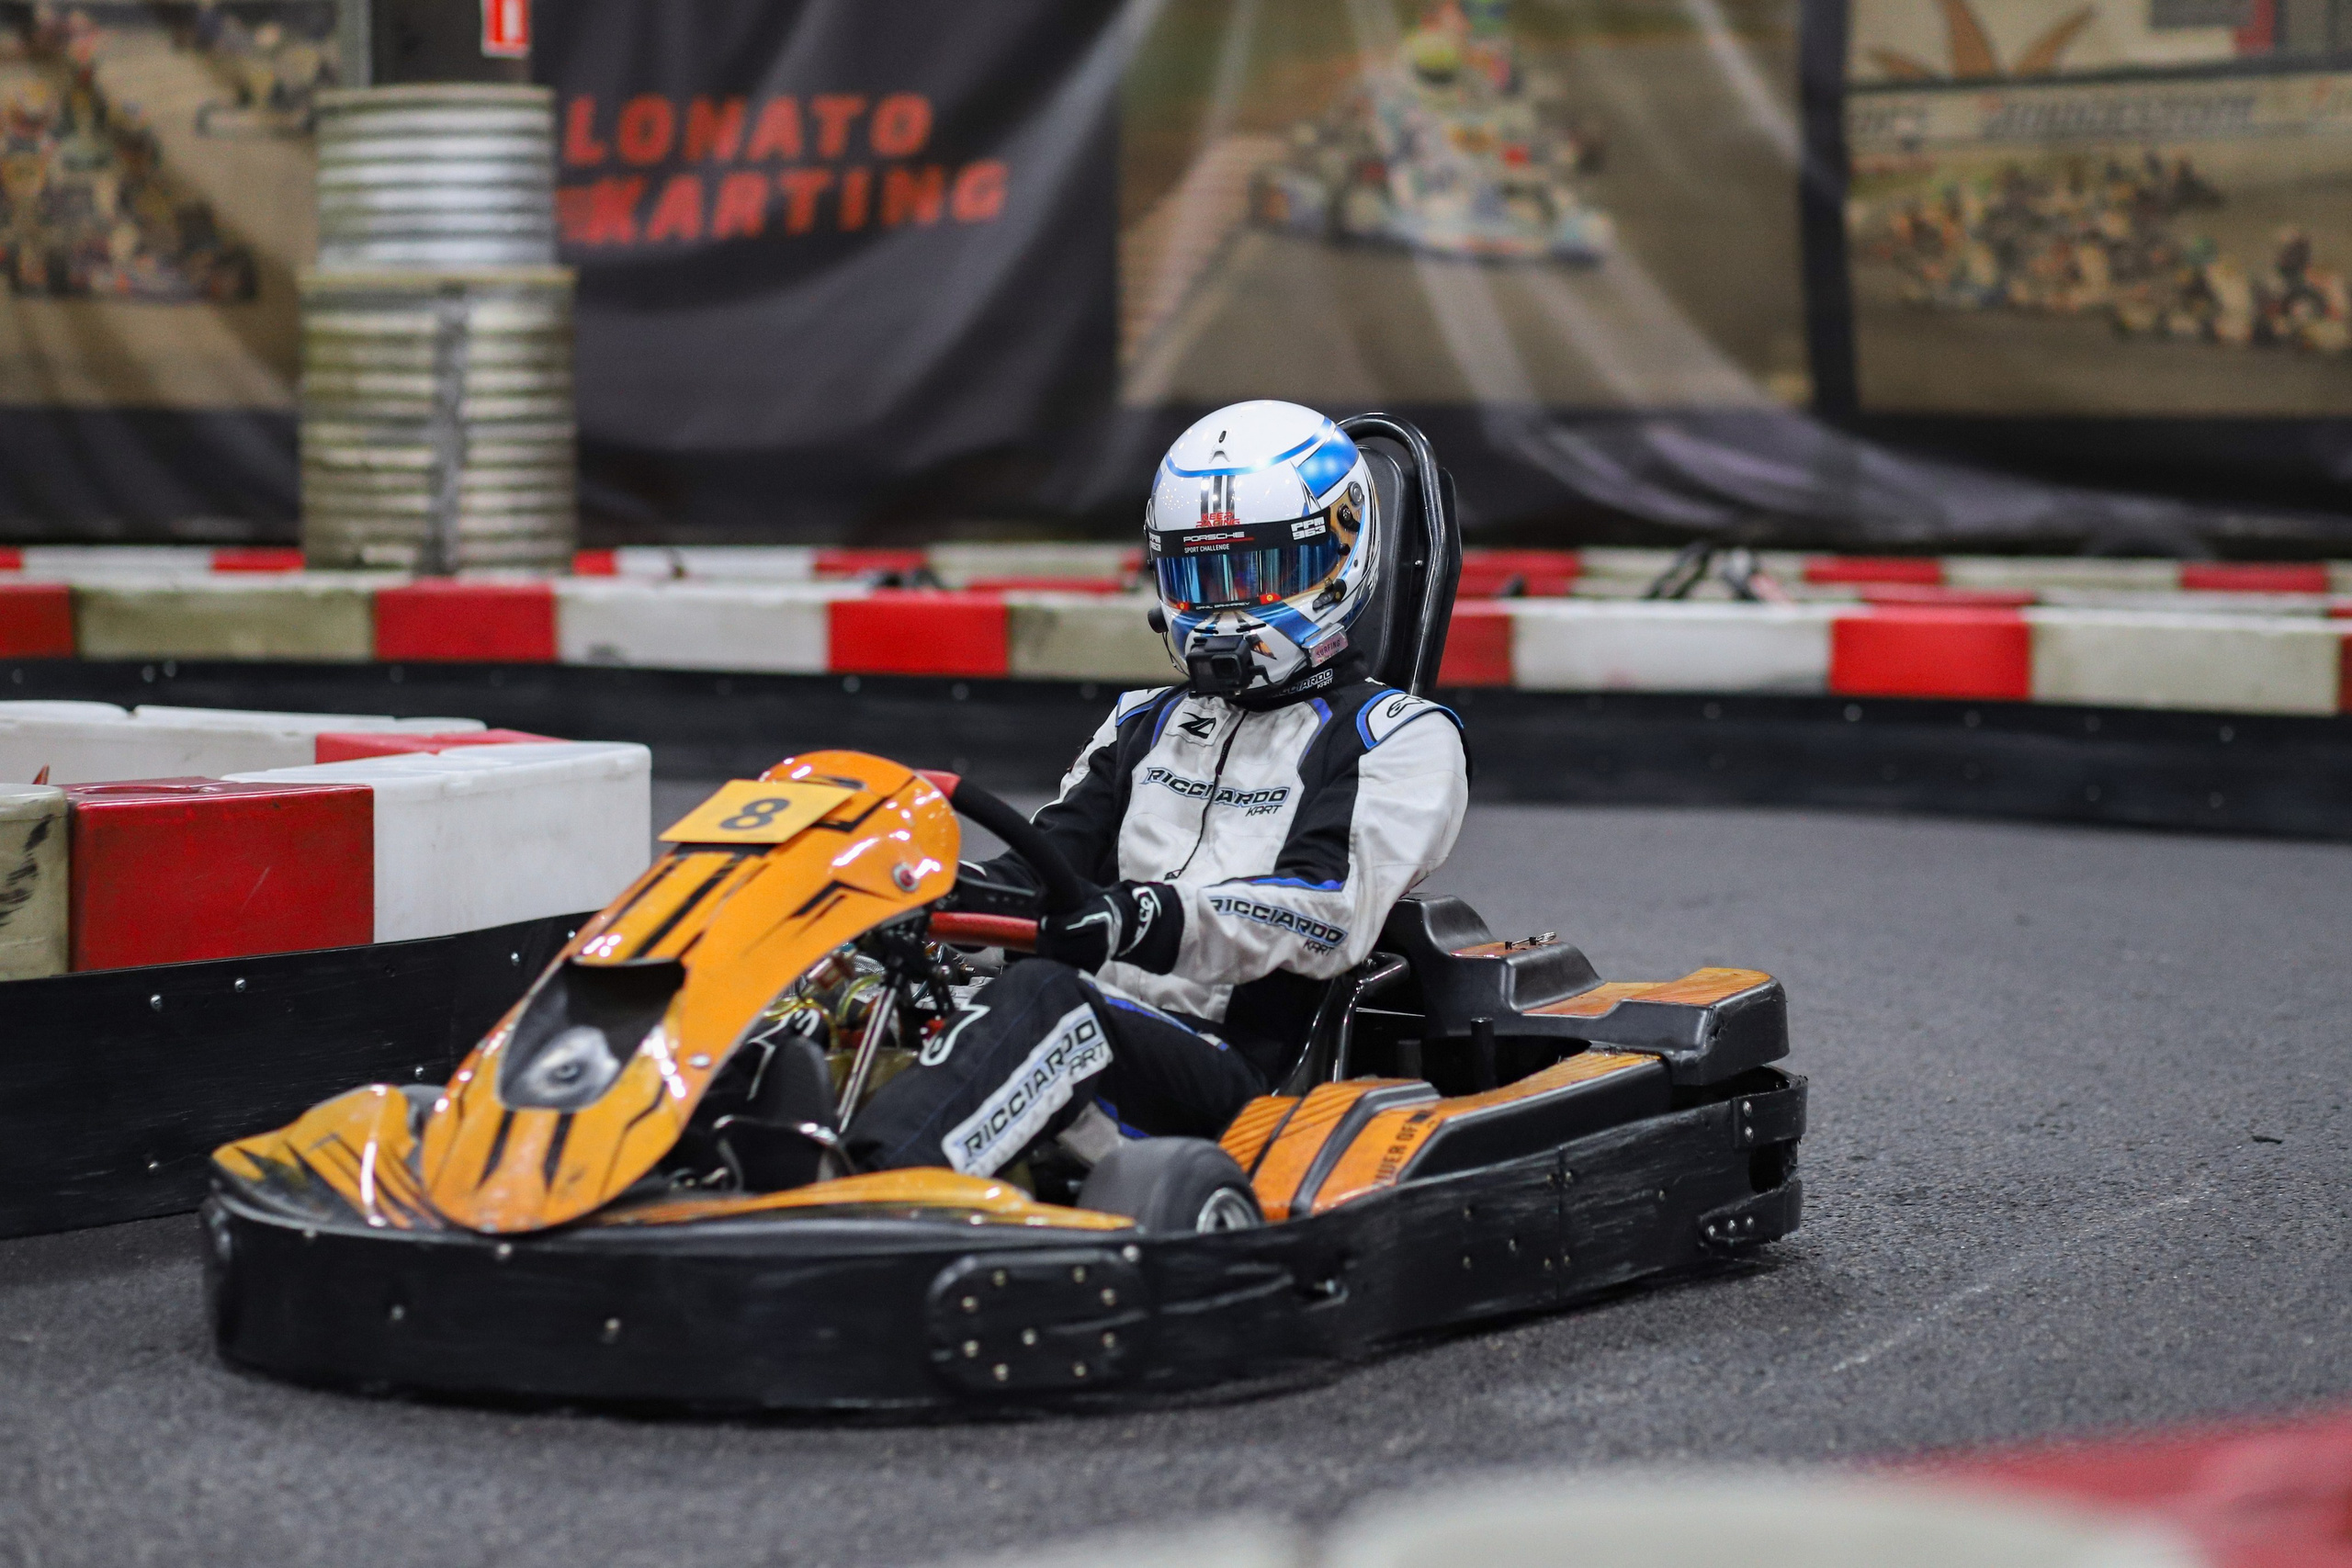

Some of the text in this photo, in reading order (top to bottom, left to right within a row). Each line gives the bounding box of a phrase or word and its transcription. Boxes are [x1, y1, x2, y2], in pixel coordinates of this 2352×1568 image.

[562, 93, 932, 166] LONATO
[582, 159, 1007, 245] KARTING
[1201, 512, 1234, 521] KEEP
[1291, 516, 1325, 532] PPM
[1183, 531, 1245, 543] PORSCHE
[1293, 525, 1327, 540] 963
[1200, 543, 1230, 553] CHALLENGE
[1317, 678, 1334, 689] KART
[1147, 768, 1288, 805] RICCIARDO
[719, 797, 791, 829] 8
[1245, 805, 1283, 817] KART
[1210, 899, 1344, 943] RICCIARDO
[1303, 939, 1334, 956] KART
[1069, 1042, 1105, 1077] ART
